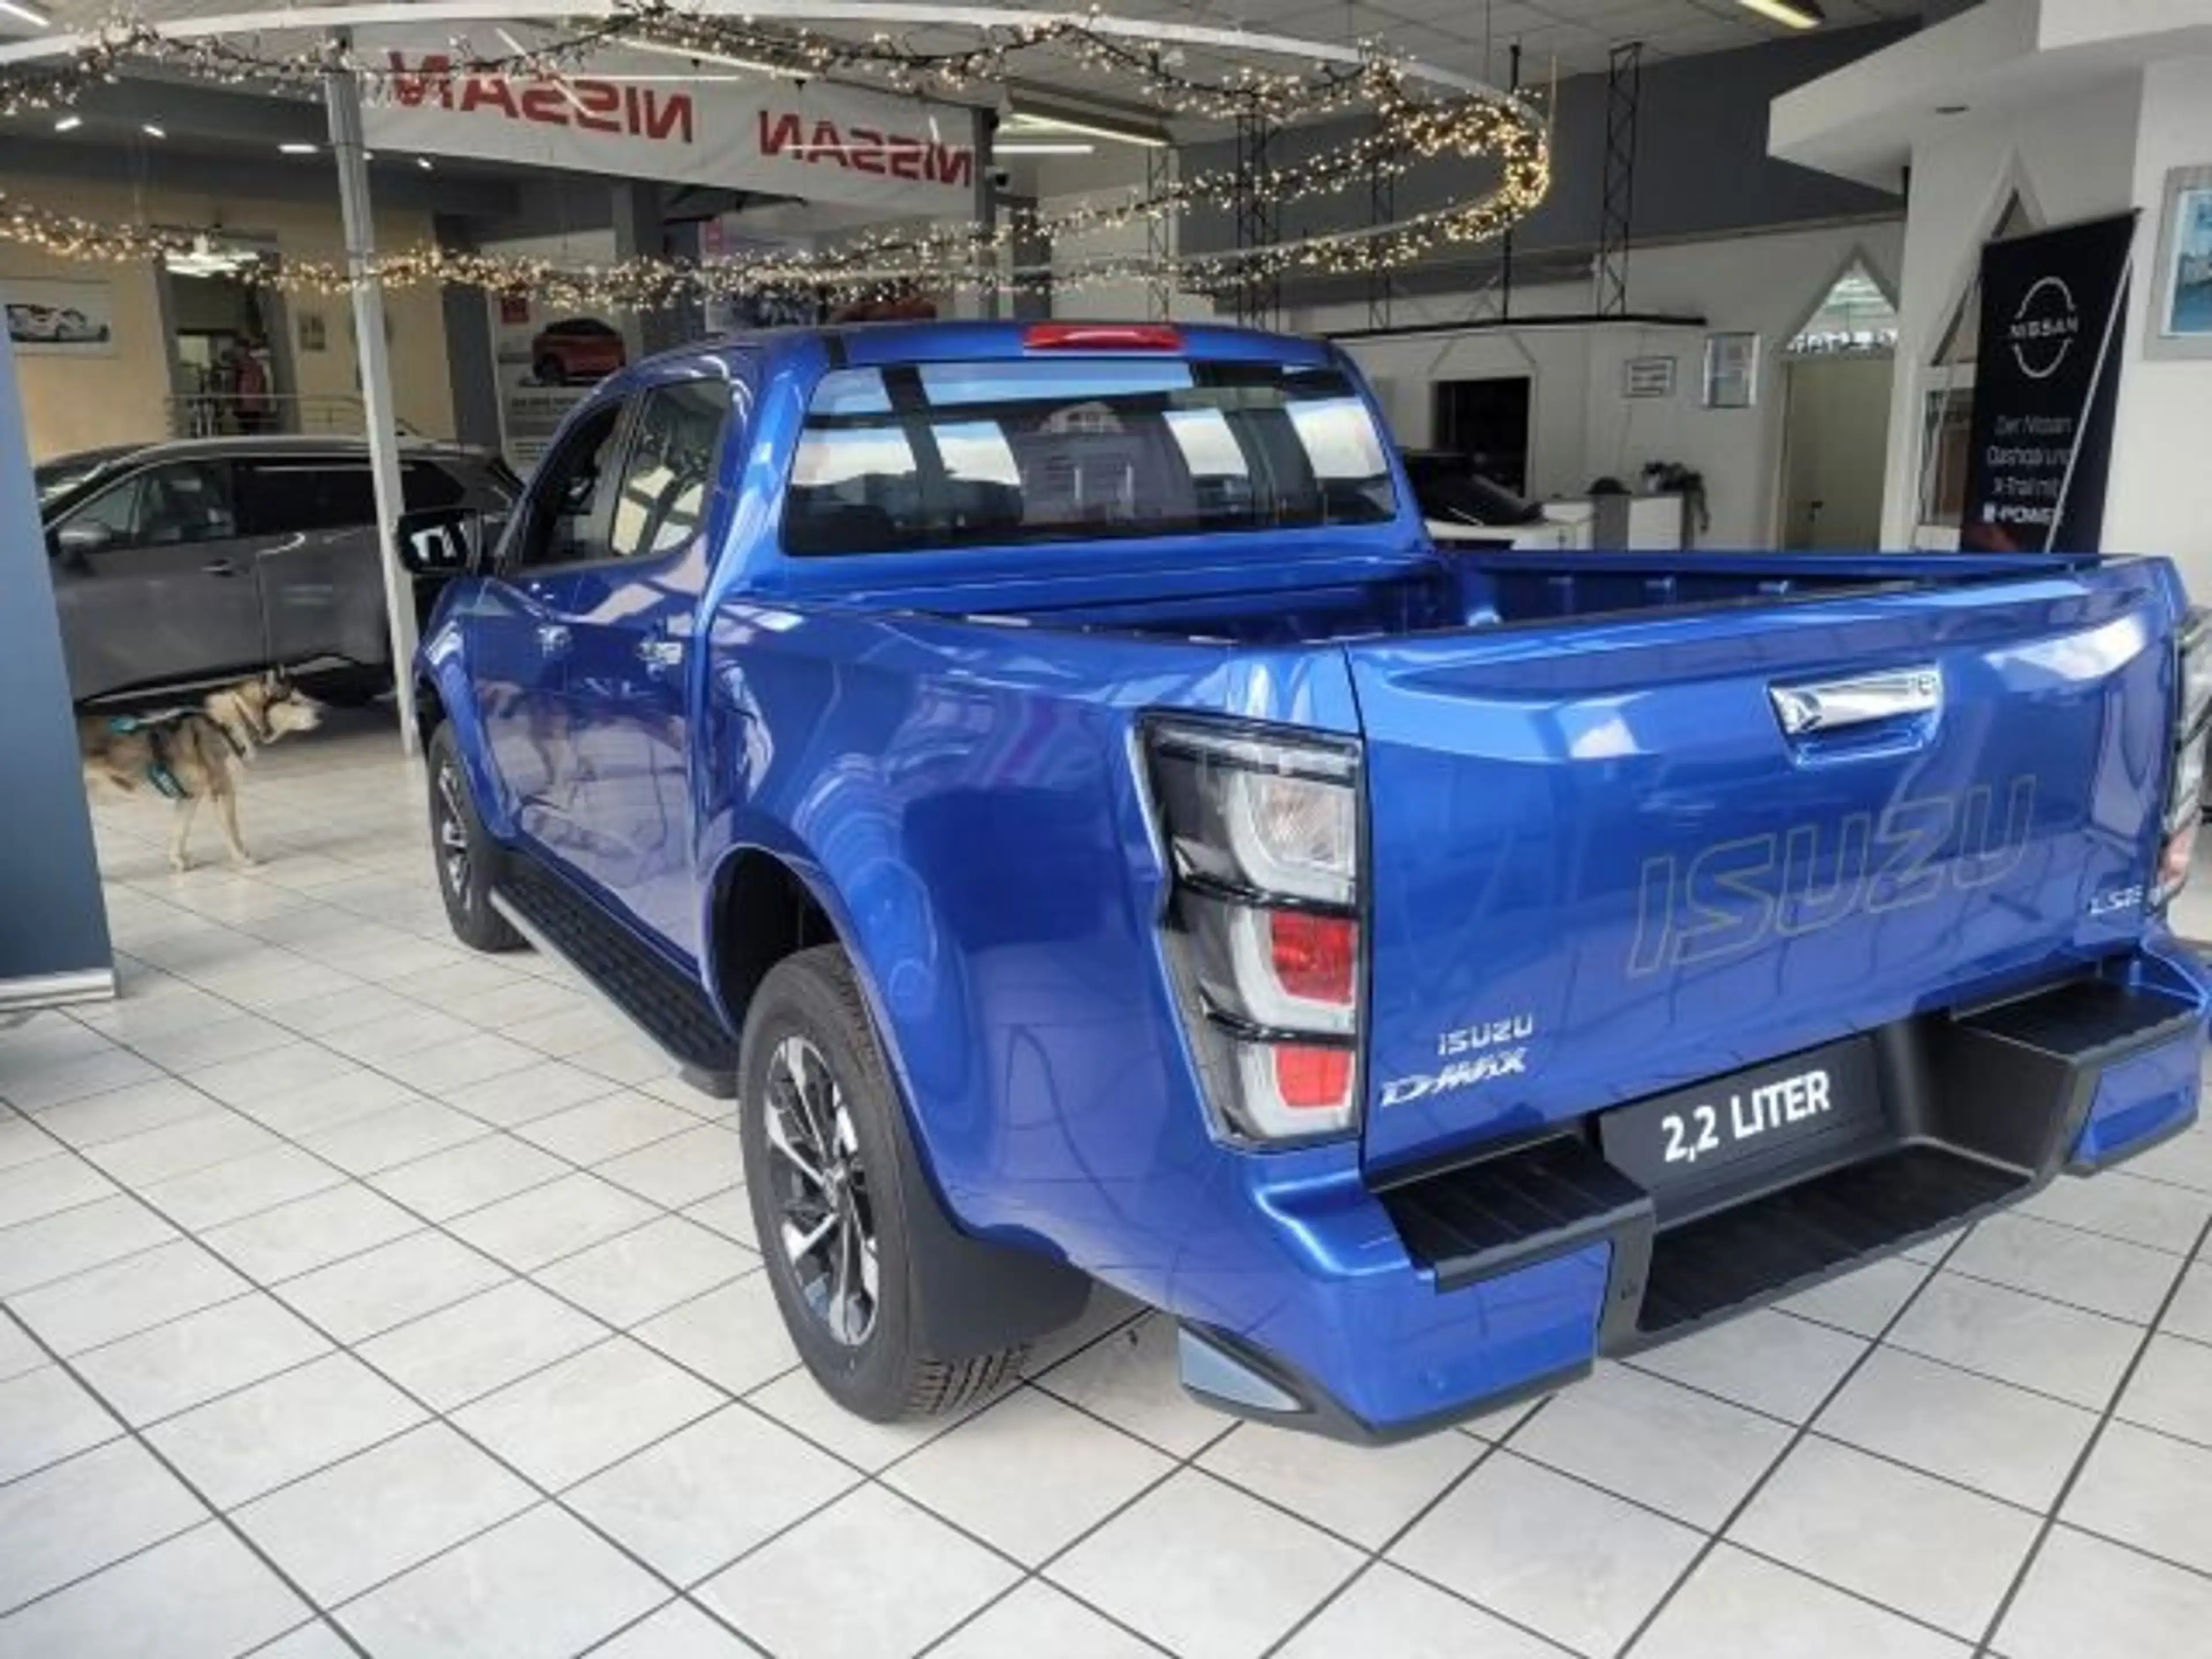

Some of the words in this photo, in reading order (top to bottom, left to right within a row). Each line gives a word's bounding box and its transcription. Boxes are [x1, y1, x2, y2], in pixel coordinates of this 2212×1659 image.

[2009, 317, 2079, 339] NISSAN
[1627, 775, 2037, 978] ISUZU
[1437, 1013, 1533, 1056] ISUZU
[1661, 1105, 1720, 1163] 2,2
[1730, 1070, 1831, 1139] LITER
